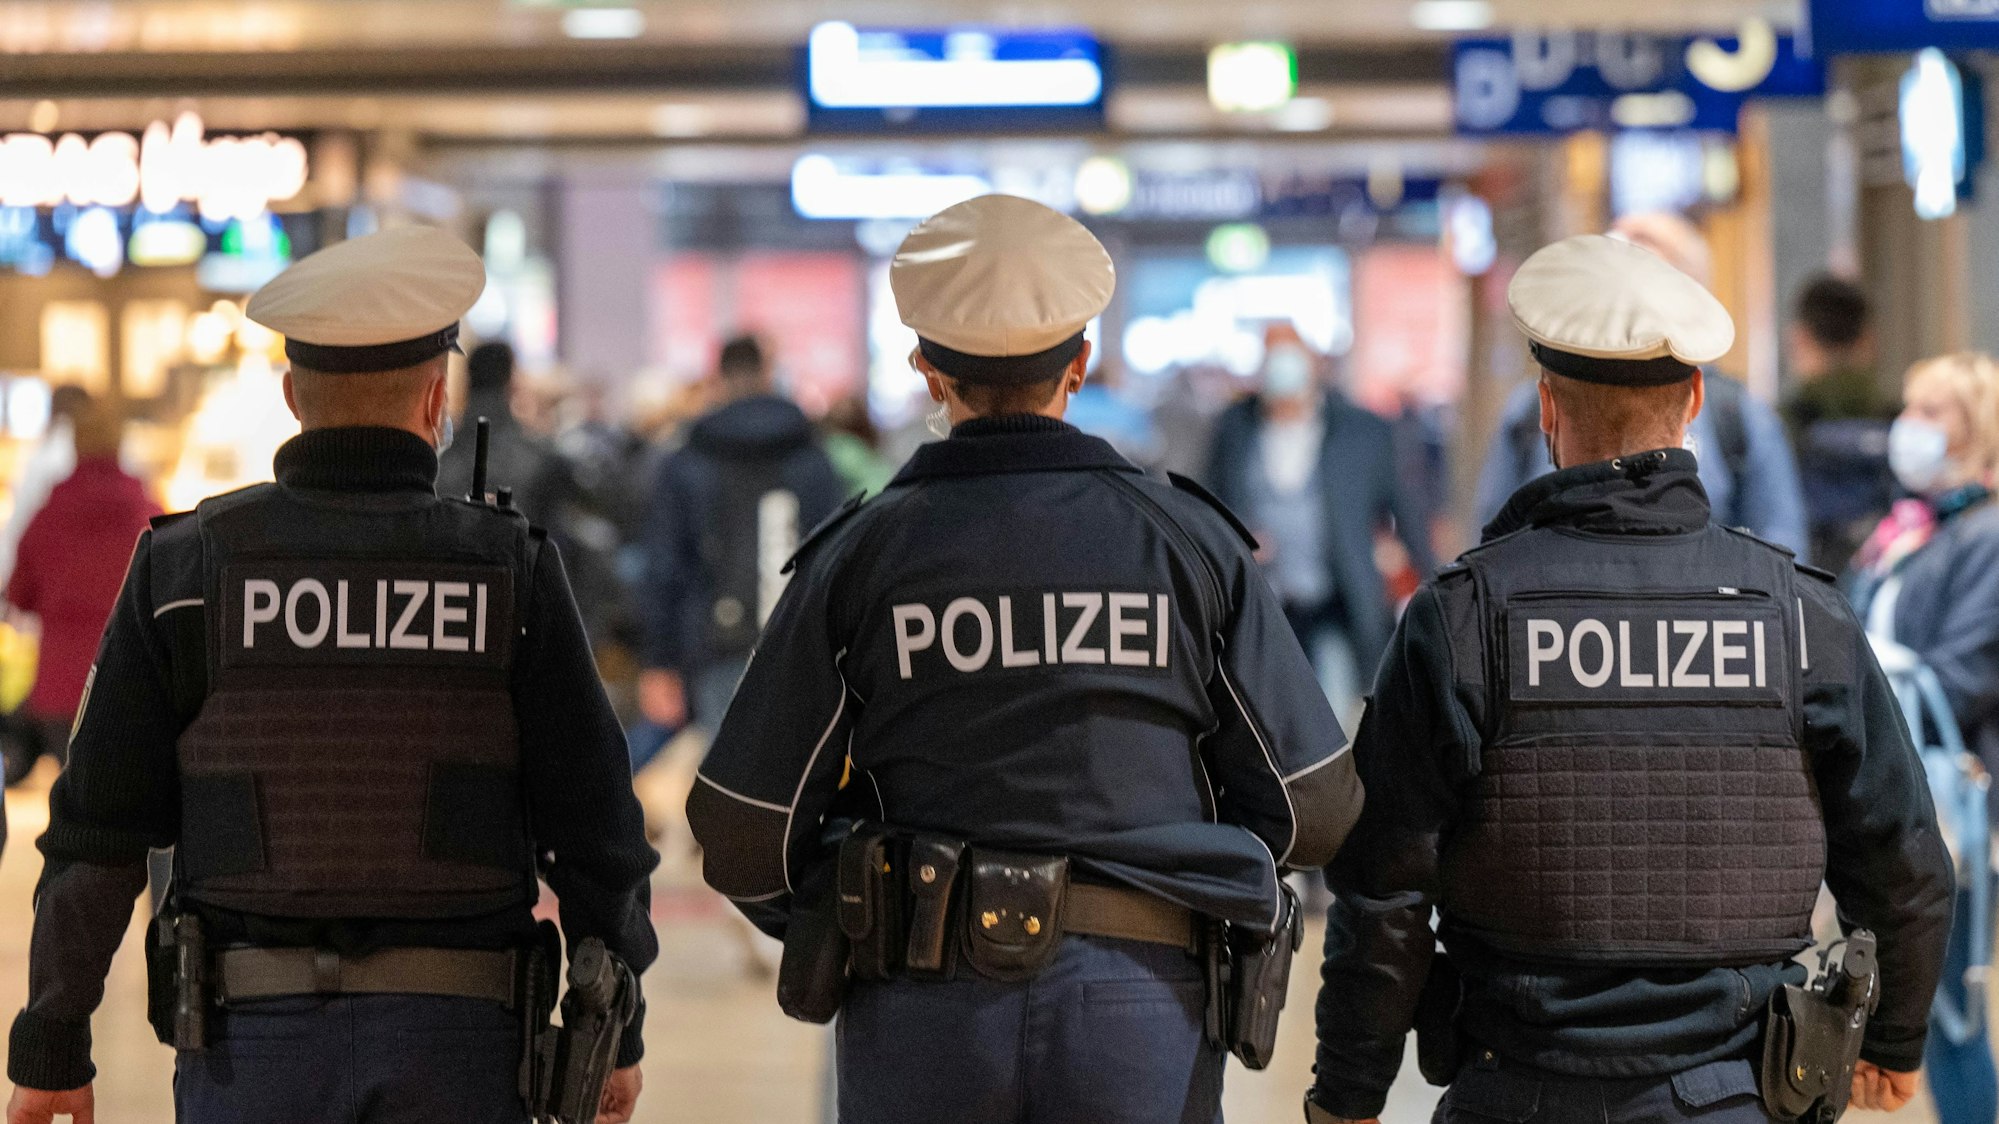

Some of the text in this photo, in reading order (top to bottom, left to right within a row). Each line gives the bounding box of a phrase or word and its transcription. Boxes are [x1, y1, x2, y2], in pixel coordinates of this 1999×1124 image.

[243, 578, 488, 652] POLIZEI
[892, 592, 1169, 679] POLIZEI
[1527, 618, 1767, 689] POLIZEI
